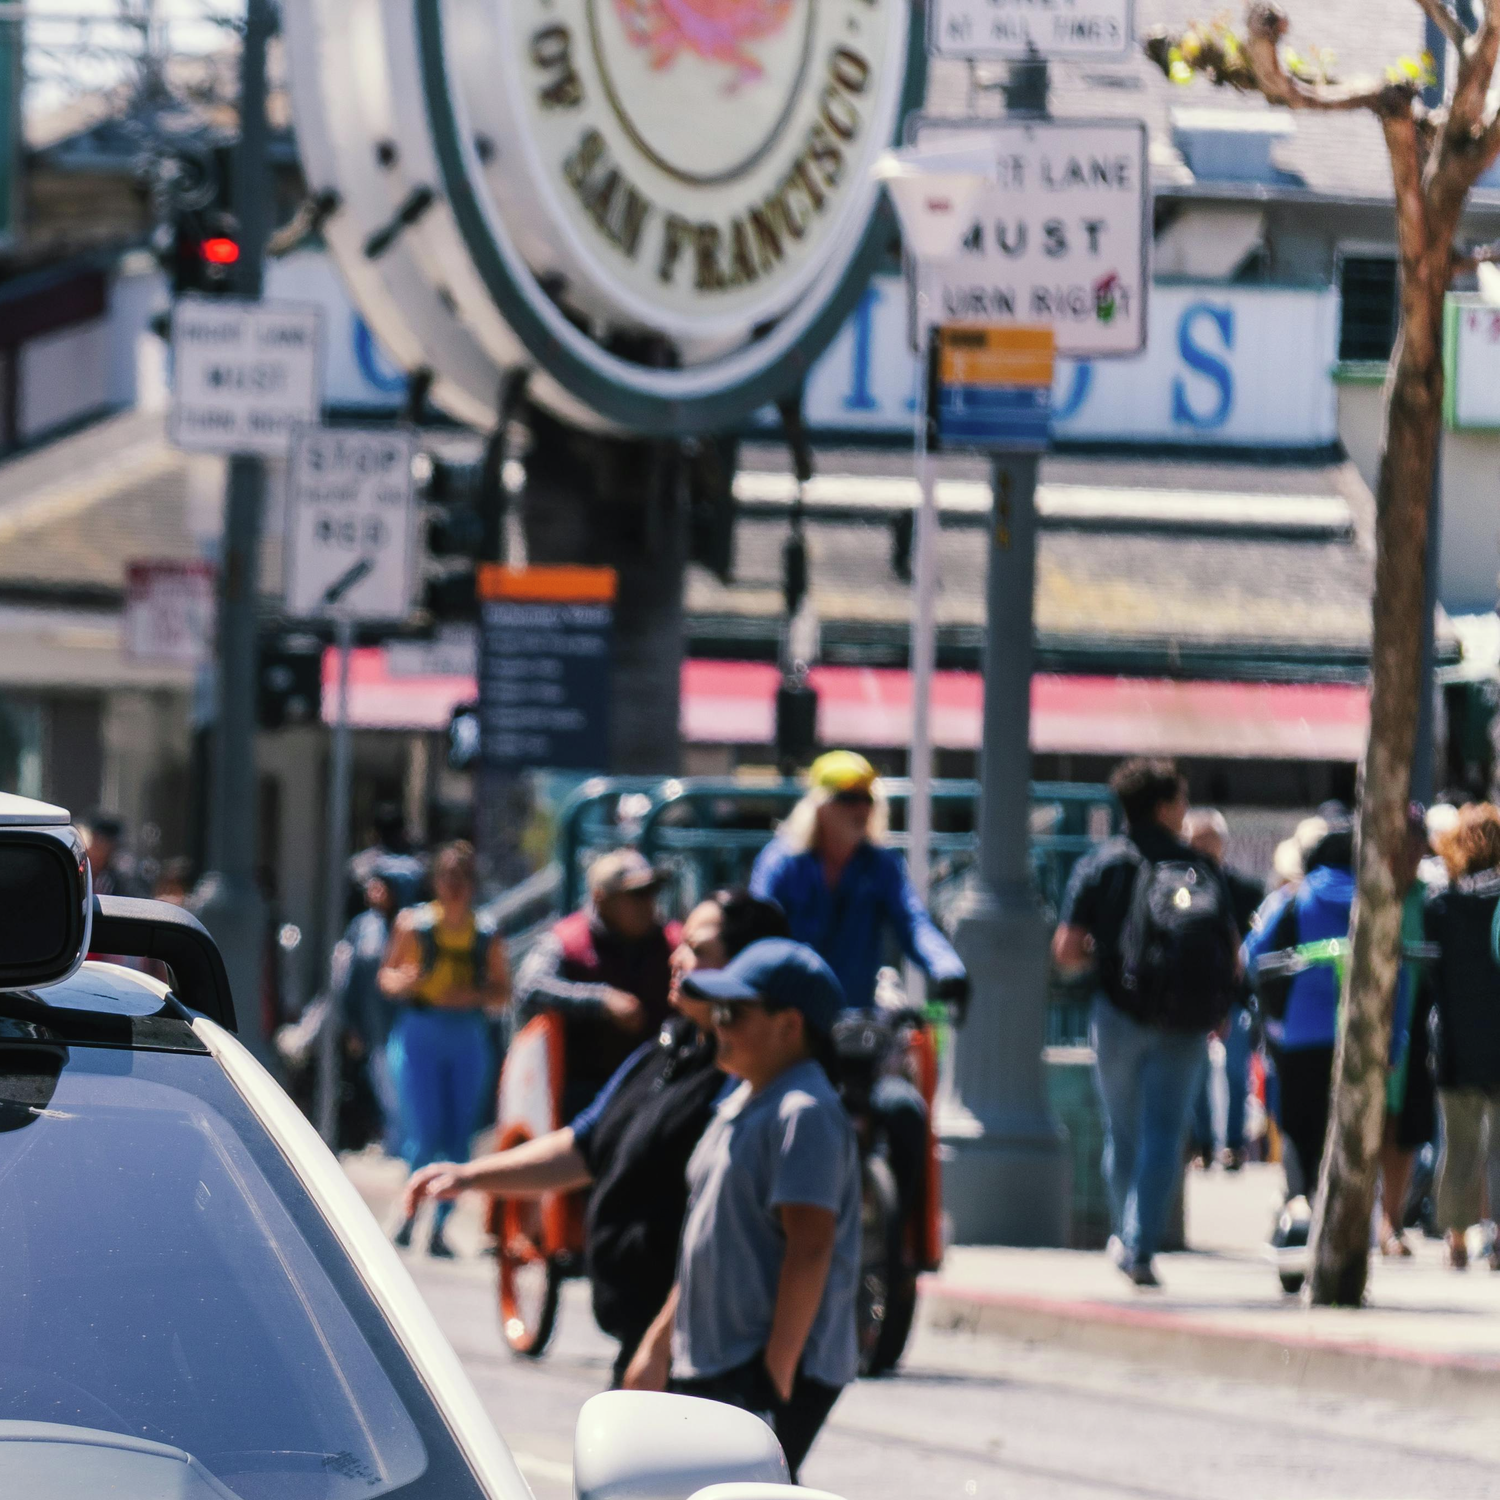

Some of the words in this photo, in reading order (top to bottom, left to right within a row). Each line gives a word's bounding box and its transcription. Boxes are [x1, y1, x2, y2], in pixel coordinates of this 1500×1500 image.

[531, 24, 585, 112] OF
[562, 128, 652, 262] SAN
[655, 42, 873, 293] FRANCISCO
[1041, 154, 1134, 191] LANE
[941, 285, 1016, 317] URN
